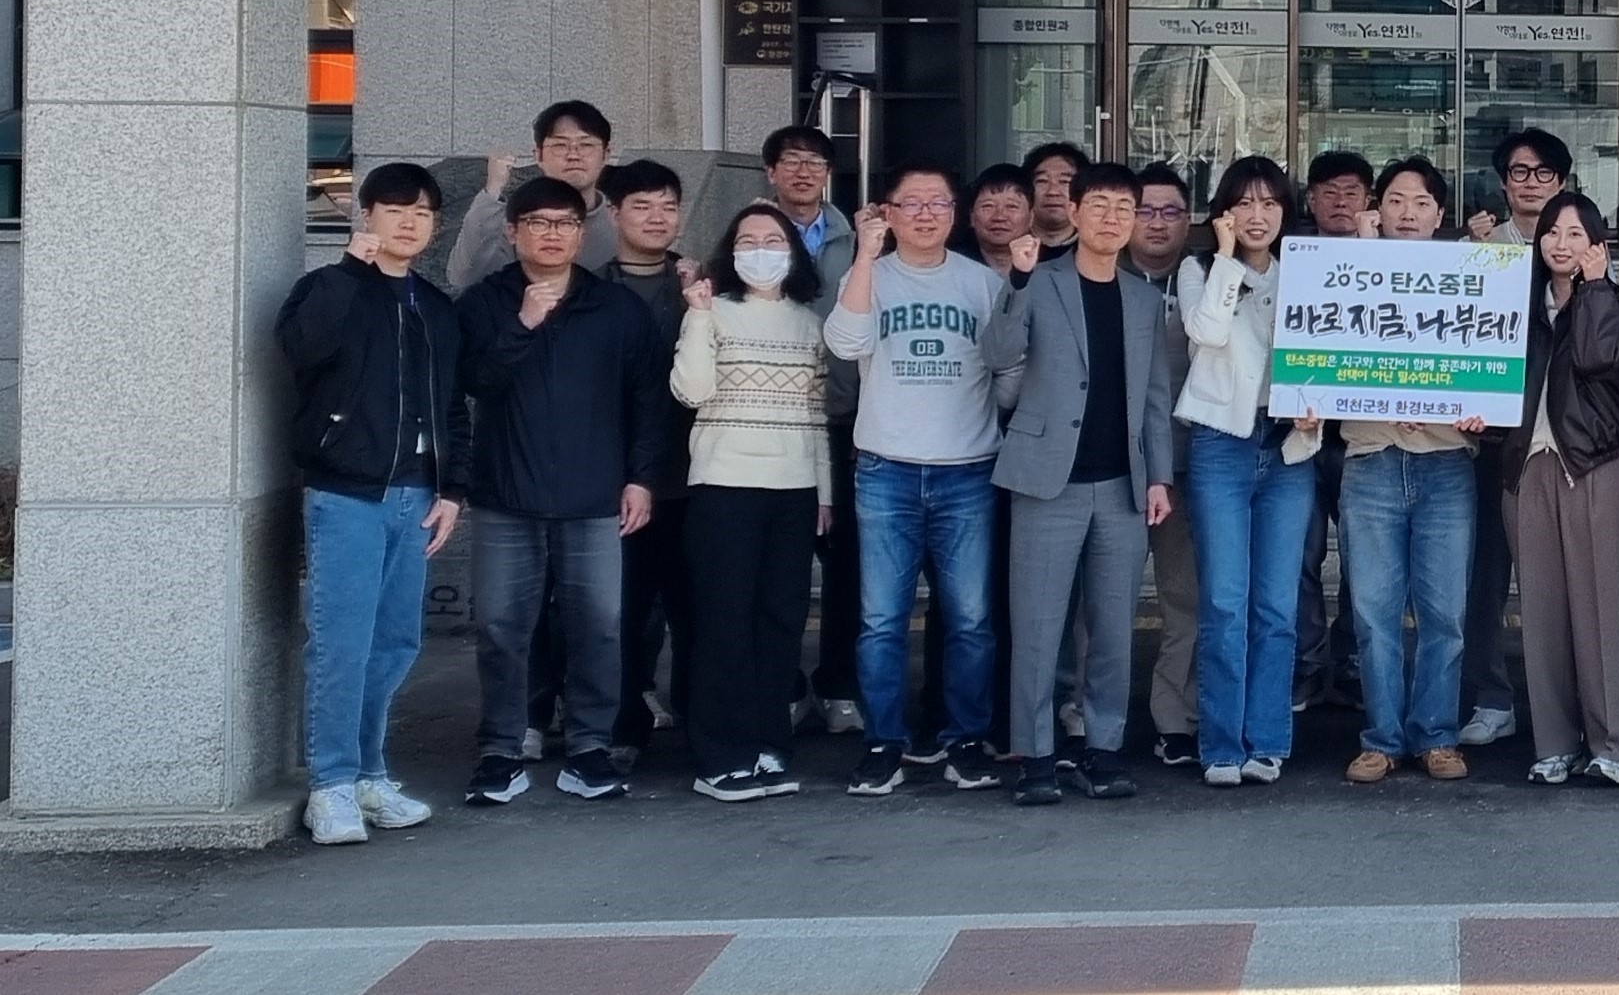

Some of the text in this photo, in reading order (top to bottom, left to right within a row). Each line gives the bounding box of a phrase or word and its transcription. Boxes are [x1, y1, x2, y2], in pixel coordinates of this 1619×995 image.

[1323, 265, 1485, 297] 2050 탄소중립
[879, 302, 978, 347] OREGON
[1284, 301, 1519, 346] 바로 지금, 나부터!
[916, 341, 937, 355] OR
[1341, 355, 1374, 370] 지구와
[1377, 357, 1409, 370] 인간이
[1438, 359, 1482, 374] 공존하기
[1485, 361, 1508, 375] 위한
[1336, 368, 1368, 382] 선택이
[1371, 369, 1393, 383] 아닌
[1335, 397, 1463, 417] 연천군청 환경보호과
